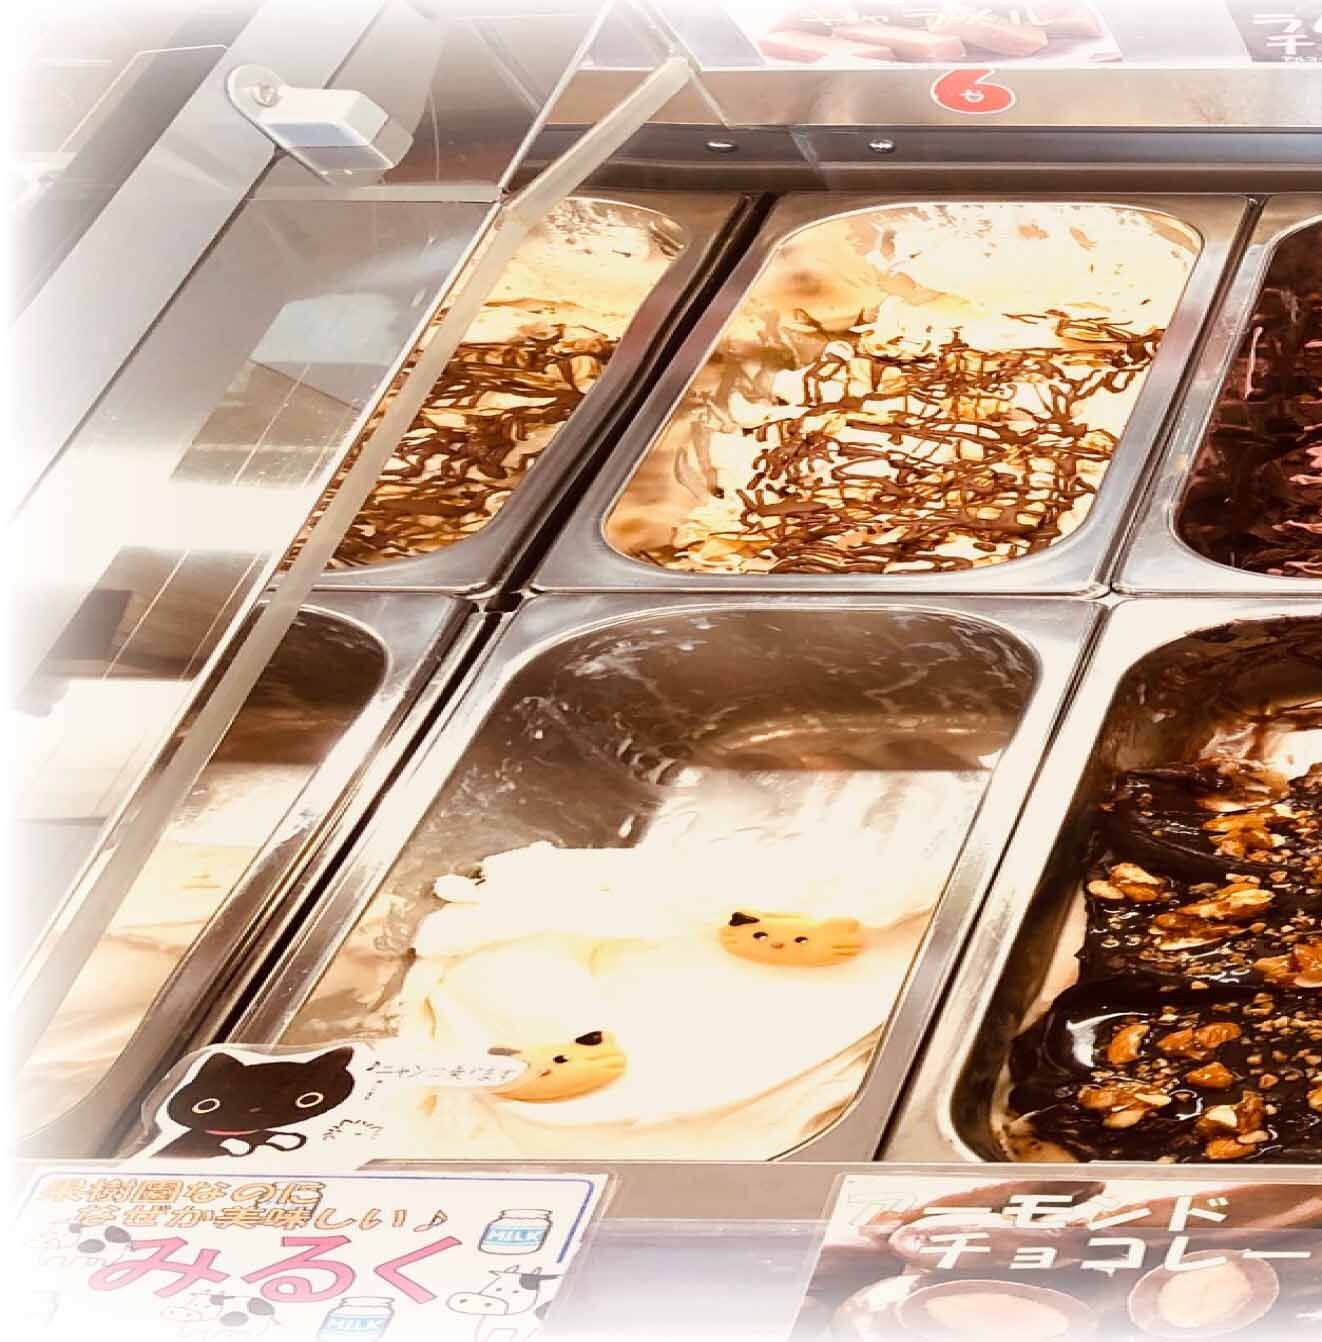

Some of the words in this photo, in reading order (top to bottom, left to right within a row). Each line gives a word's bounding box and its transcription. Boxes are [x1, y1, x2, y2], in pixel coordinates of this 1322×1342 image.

[929, 68, 1017, 115] 6
[486, 1228, 545, 1244] MILK
[88, 1235, 463, 1304] みるく
